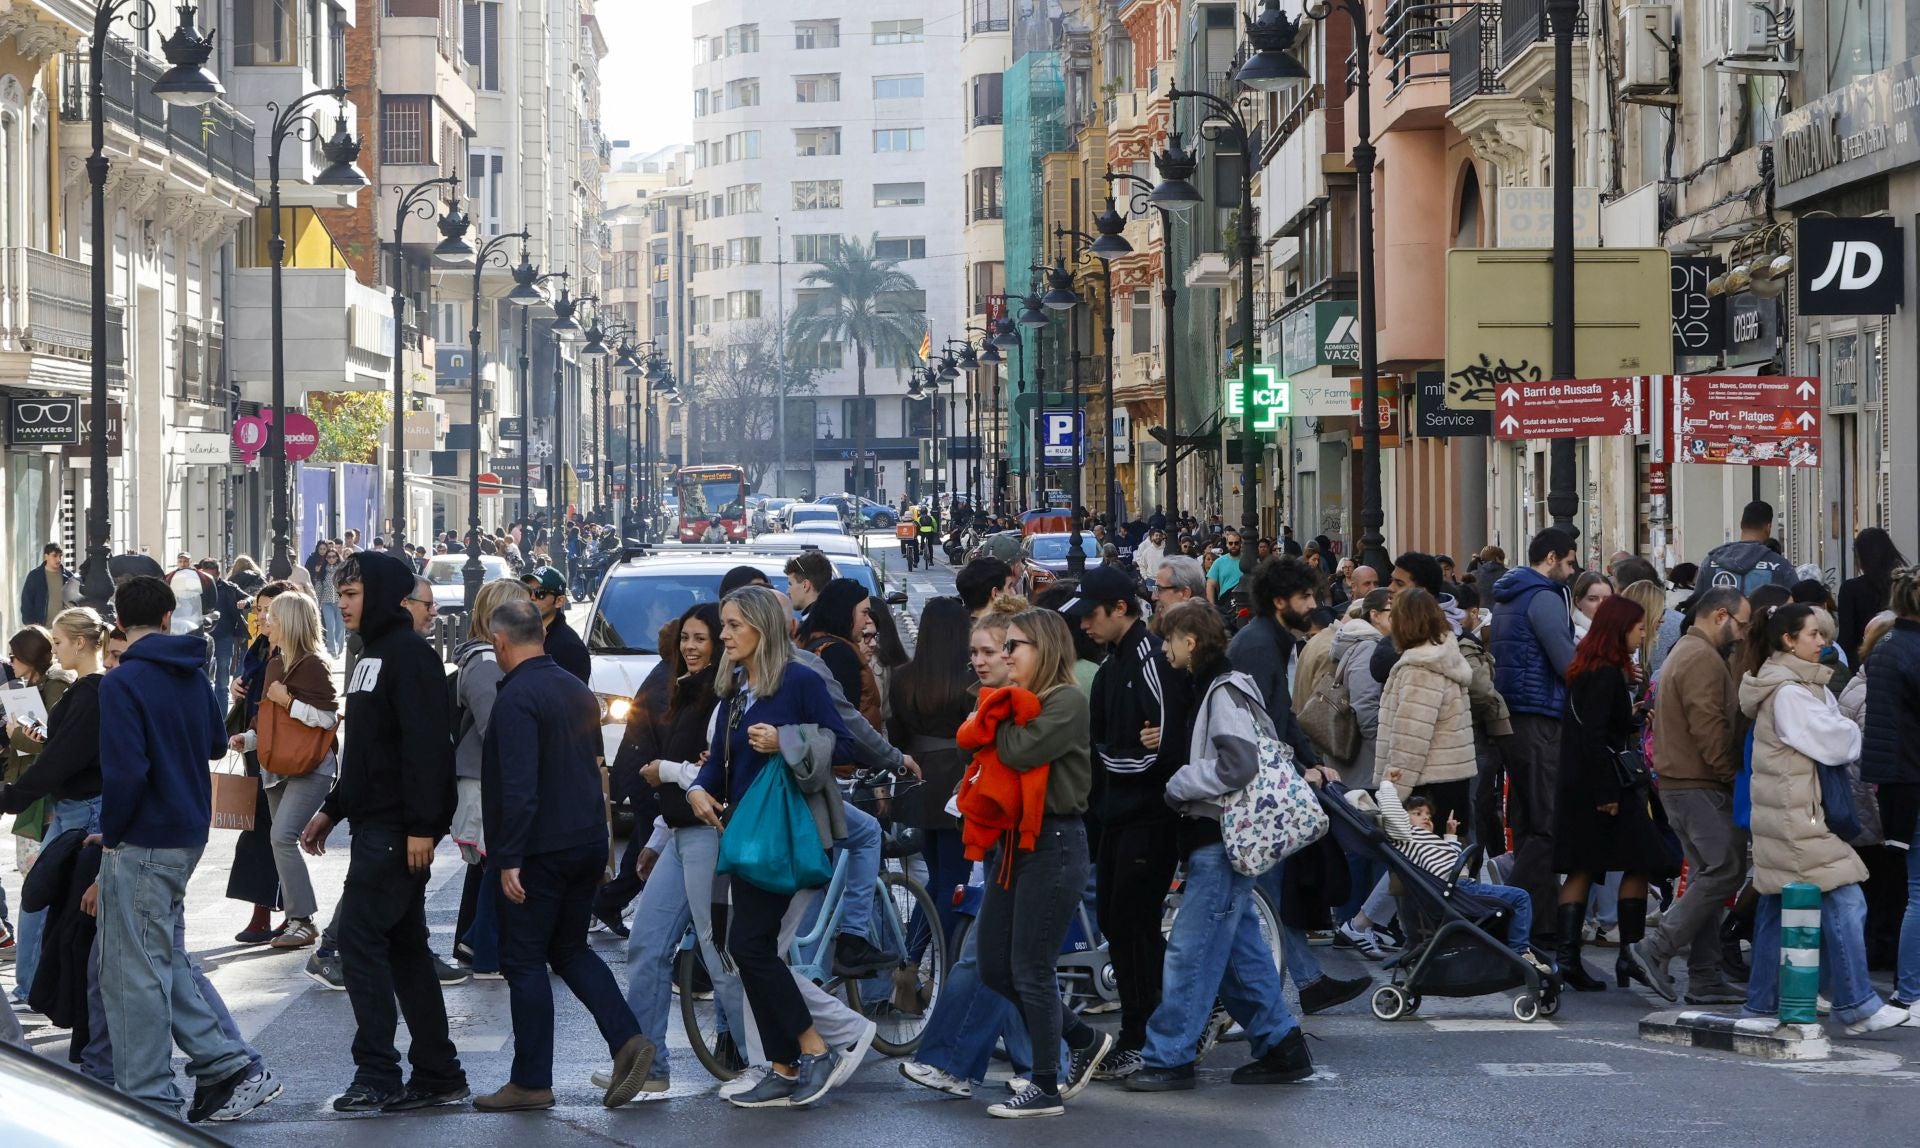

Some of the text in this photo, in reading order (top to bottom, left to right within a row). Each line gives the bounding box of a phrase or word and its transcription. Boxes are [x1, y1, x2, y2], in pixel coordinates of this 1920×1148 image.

[1810, 240, 1884, 292] JD
[1671, 265, 1710, 291] ON
[1324, 350, 1360, 361] VAZQ
[1523, 384, 1602, 398] Barri de Russafa
[1426, 413, 1475, 426] Service
[1709, 410, 1729, 420] Port
[1739, 410, 1775, 423] Platges
[1049, 415, 1073, 445] P
